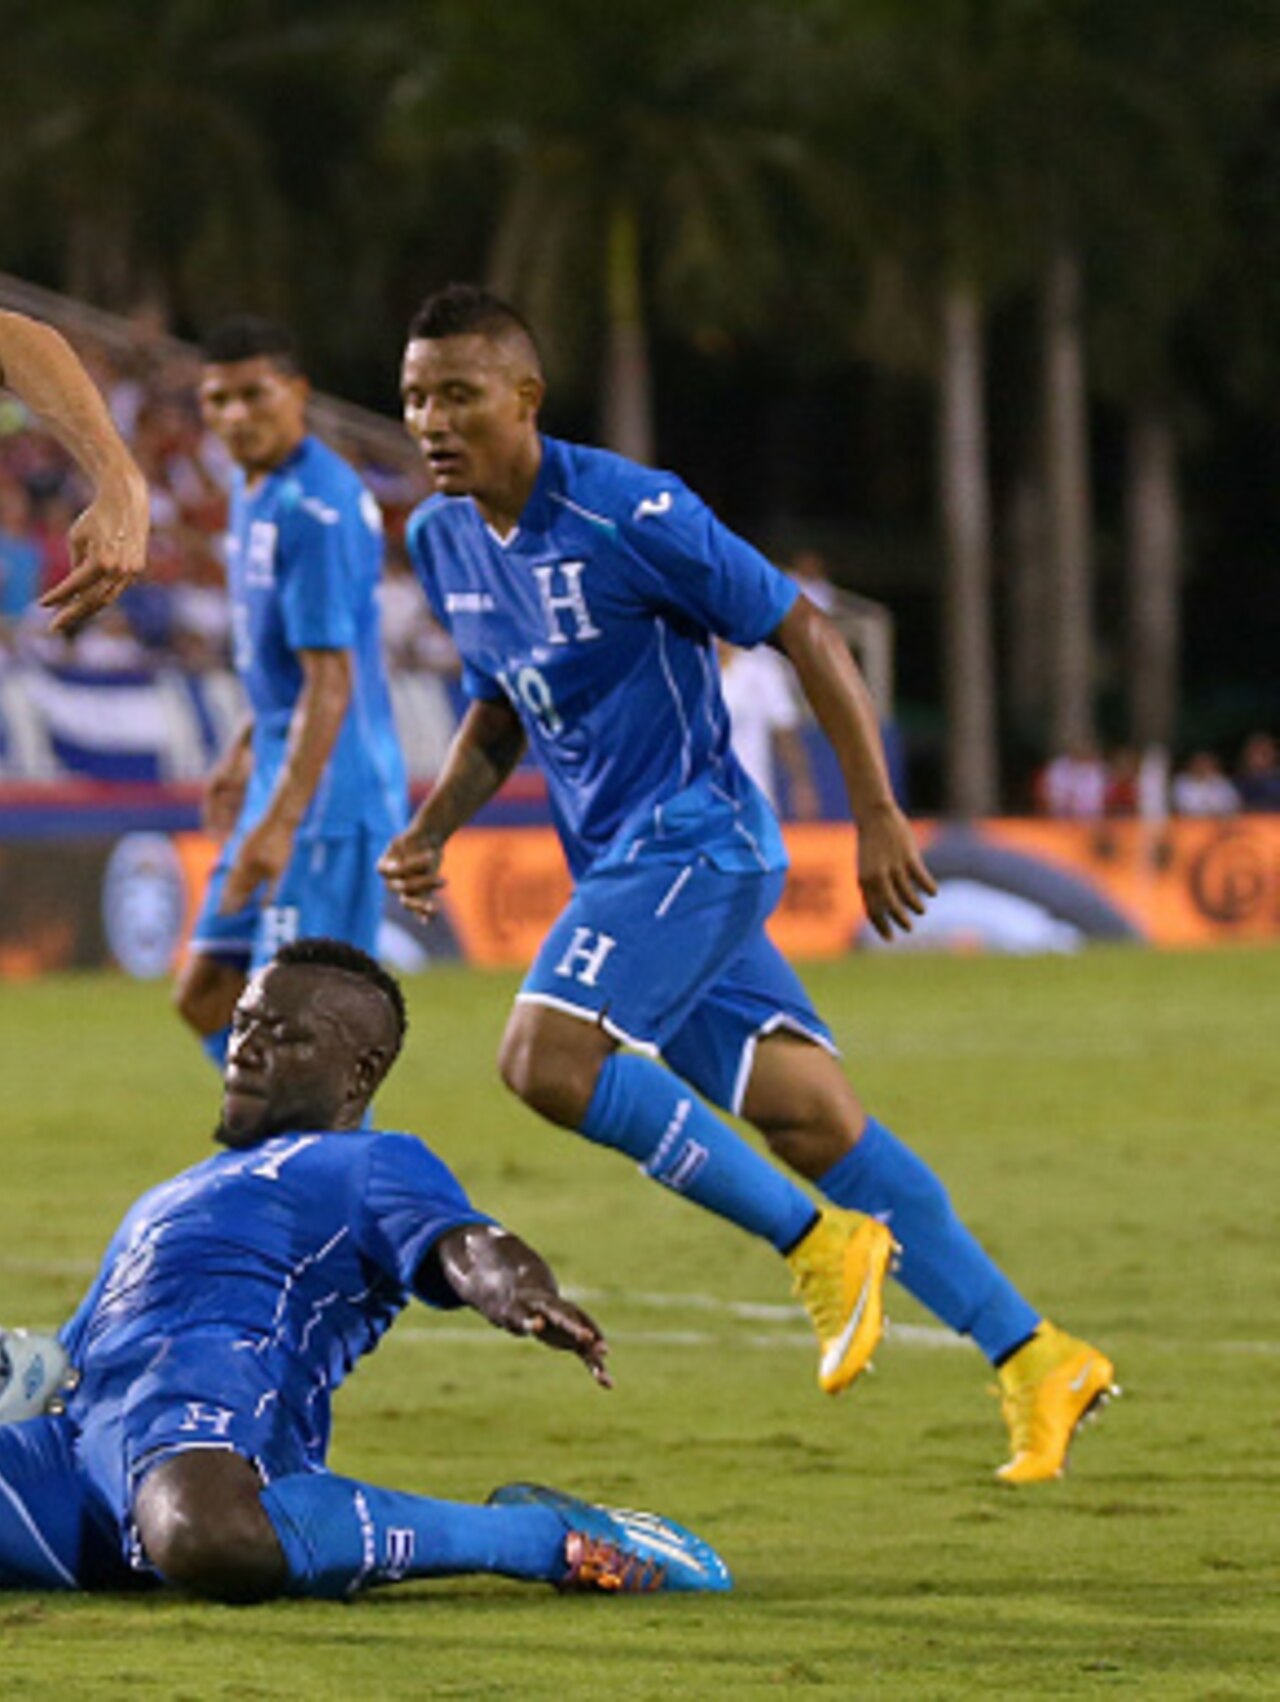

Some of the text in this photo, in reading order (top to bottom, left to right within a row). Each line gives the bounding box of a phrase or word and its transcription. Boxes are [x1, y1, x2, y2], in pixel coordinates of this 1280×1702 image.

[532, 561, 602, 643] H
[554, 926, 617, 987] H
[179, 1402, 235, 1435] H
